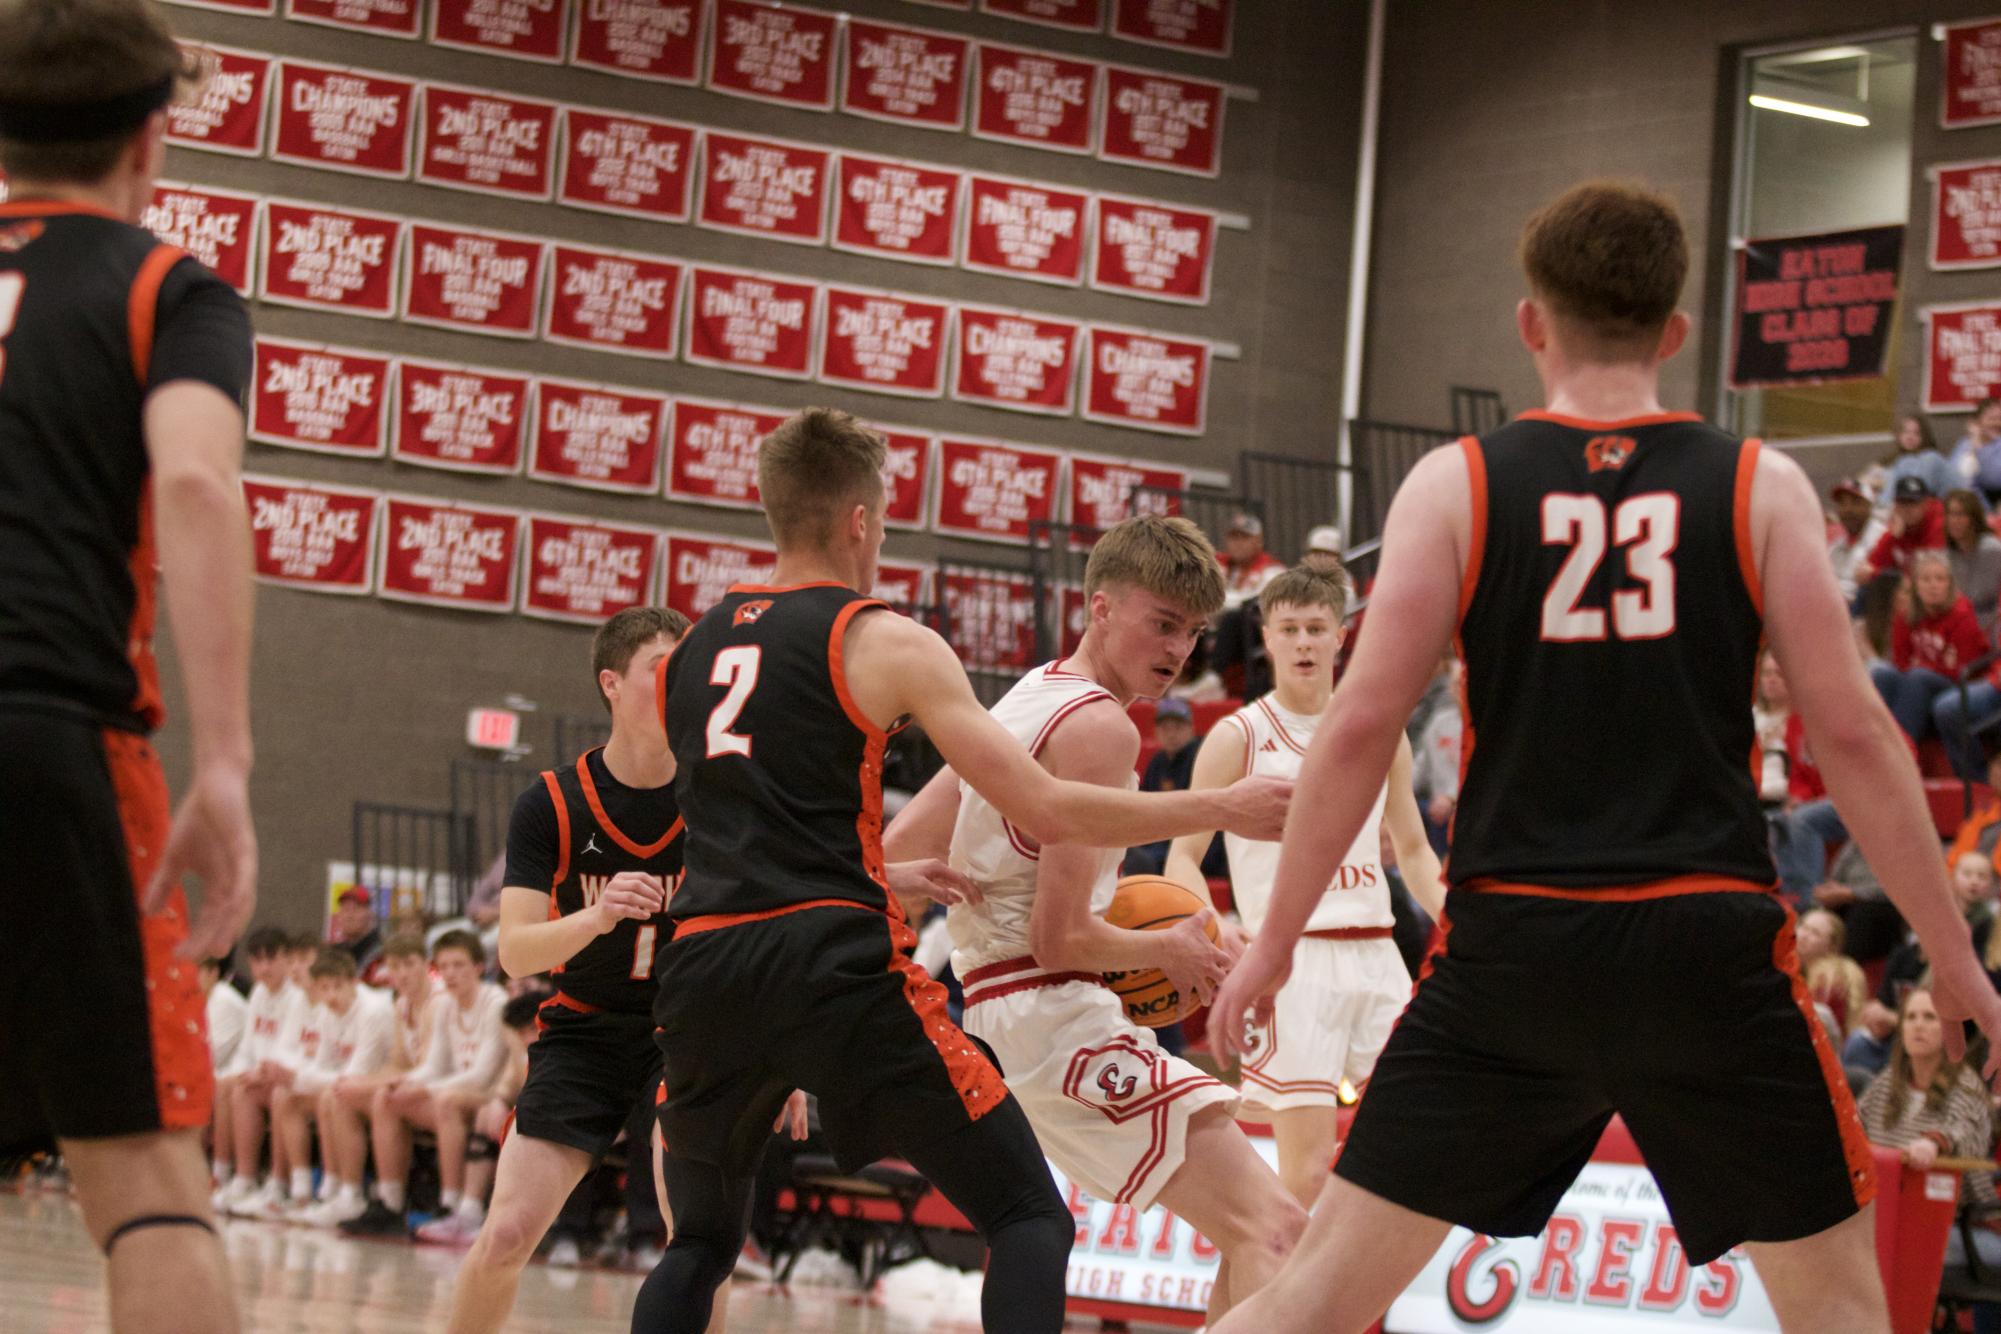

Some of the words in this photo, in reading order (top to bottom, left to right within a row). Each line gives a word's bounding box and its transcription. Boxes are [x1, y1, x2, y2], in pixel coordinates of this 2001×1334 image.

[436, 104, 478, 135] 2ND
[482, 118, 542, 150] PLACE
[576, 128, 617, 159] 4TH
[621, 141, 679, 173] PLACE
[715, 150, 755, 181] 2ND
[759, 163, 814, 195] PLACE
[140, 204, 173, 231] RD
[176, 213, 236, 246] PLACE
[277, 222, 320, 253] 2ND
[324, 235, 384, 267] PLACE
[563, 264, 604, 294] 2ND
[608, 277, 666, 309] PLACE
[266, 361, 308, 391] 2ND
[313, 373, 372, 405] PLACE
[410, 382, 450, 412] 3RD
[455, 394, 512, 424] PLACE
[729, 431, 763, 455] PLA
[252, 499, 294, 528] 2ND
[299, 510, 359, 541] PLACE
[397, 518, 439, 547] 2ND
[444, 529, 503, 560] PLACE
[539, 536, 579, 566] 4TH
[583, 548, 641, 579] PLACE
[1540, 491, 1681, 643] 23
[705, 644, 762, 760] 2
[630, 924, 657, 980] 1
[1128, 990, 1180, 1017] NCA
[1067, 1263, 1125, 1293] IGH
[1140, 1274, 1215, 1304] SCHO
[1528, 1213, 1744, 1316] REDS
